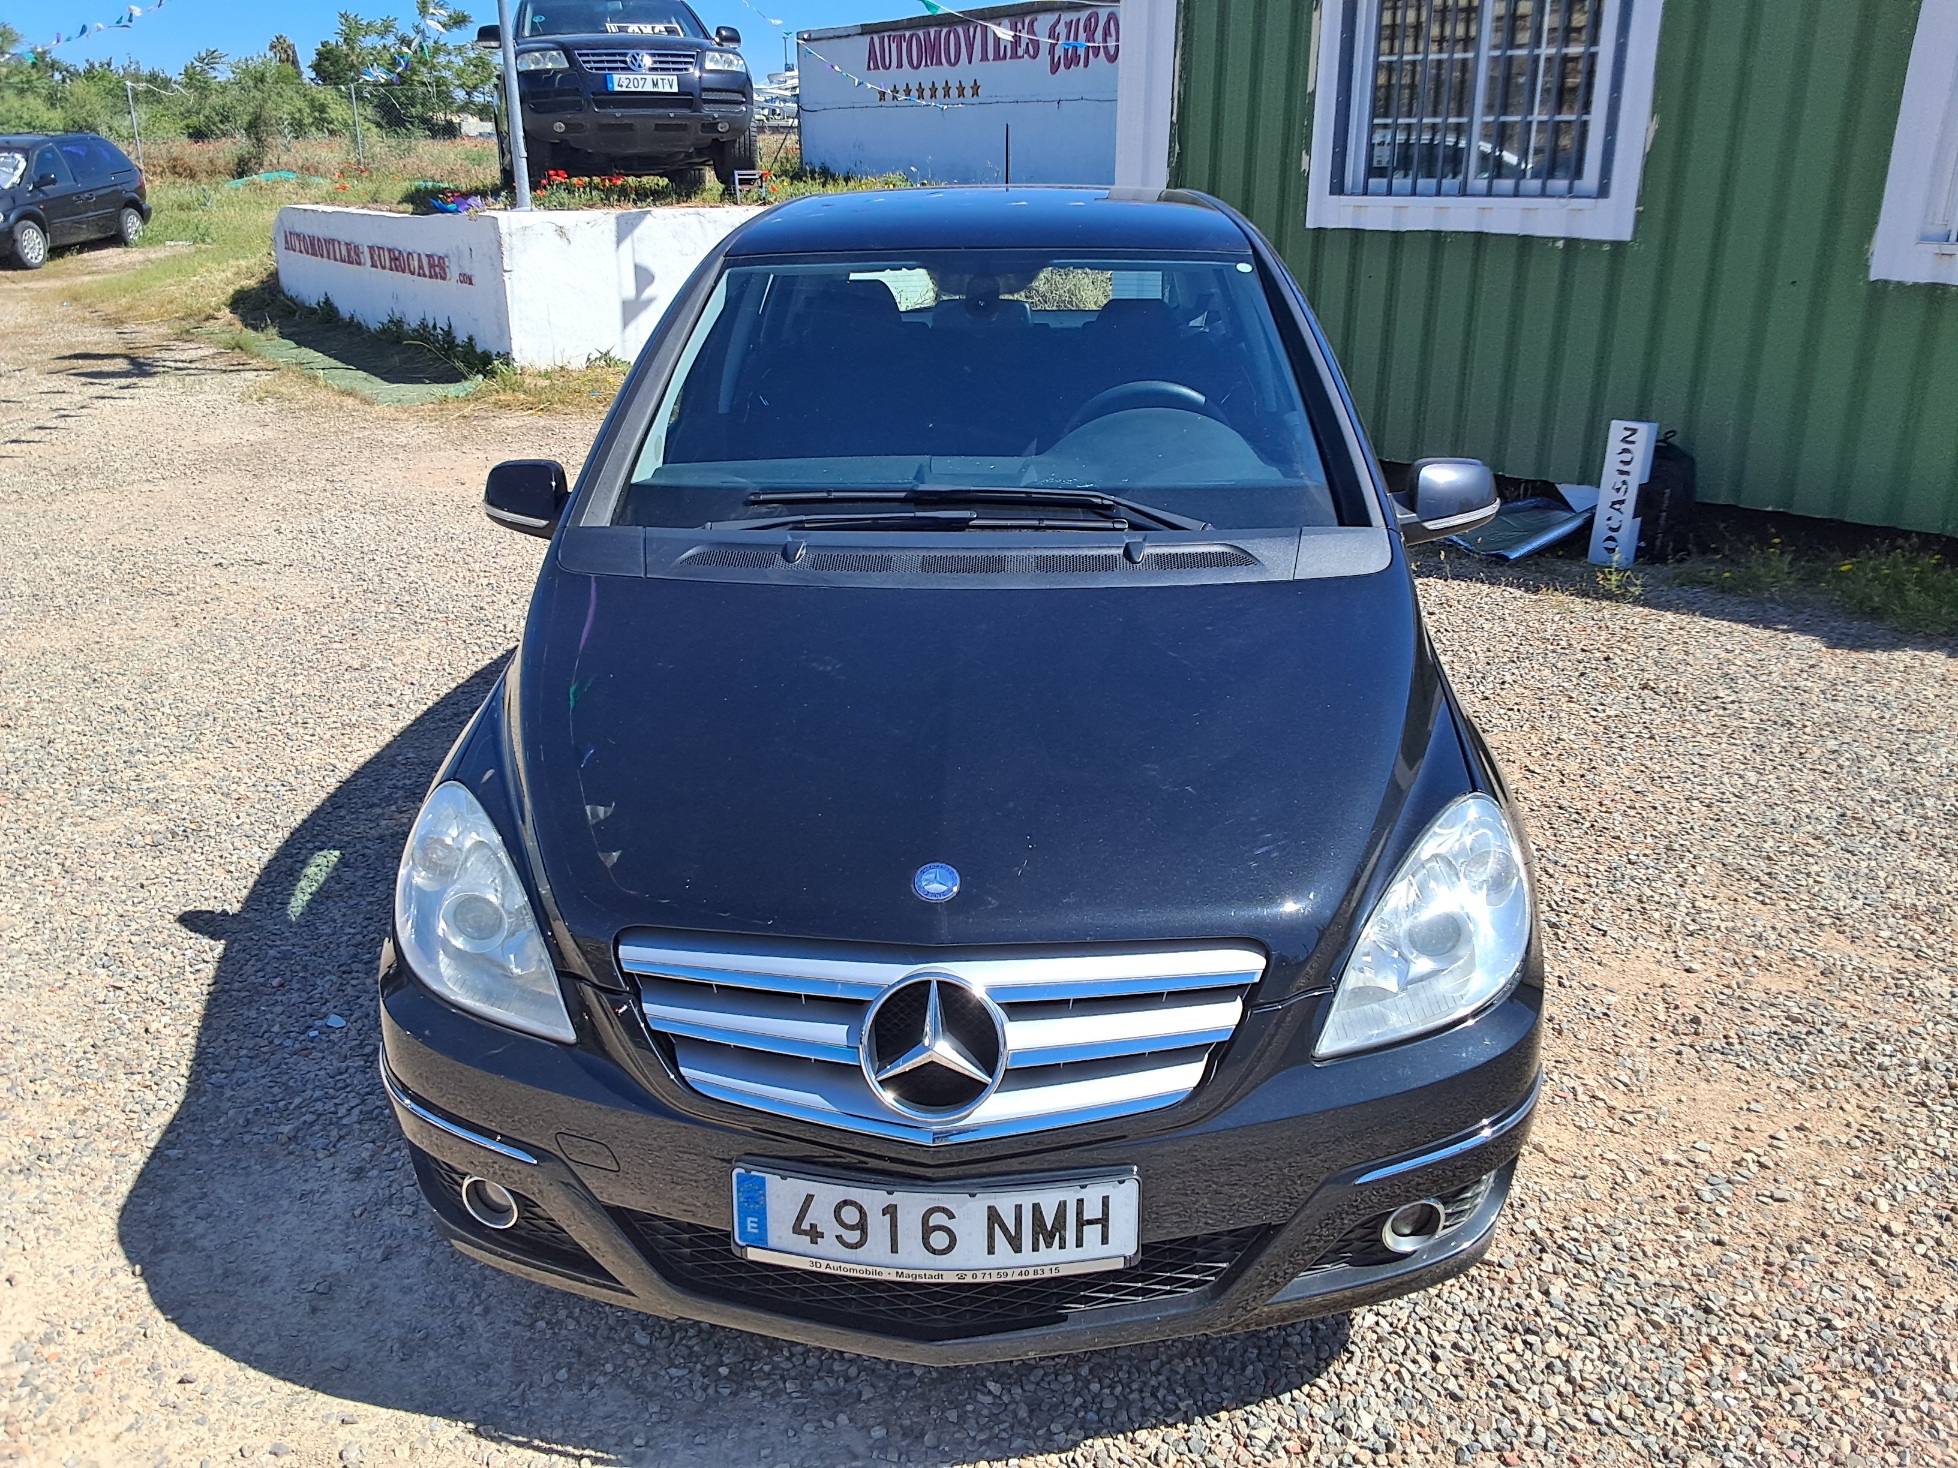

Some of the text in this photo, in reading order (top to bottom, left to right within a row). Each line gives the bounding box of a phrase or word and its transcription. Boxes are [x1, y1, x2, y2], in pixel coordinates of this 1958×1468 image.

[866, 16, 1040, 71] AUTOMOVILES
[617, 77, 647, 89] 4207
[651, 77, 674, 90] MTV
[283, 229, 363, 267] AUTOMOVILES
[367, 245, 448, 281] EUROCARS
[1602, 426, 1639, 554] OCASION
[747, 1219, 759, 1233] E
[791, 1193, 1111, 1256] 4916 NMH
[809, 1260, 822, 1269] 3D
[825, 1262, 884, 1277] Automobile
[895, 1270, 944, 1281] Magstadt
